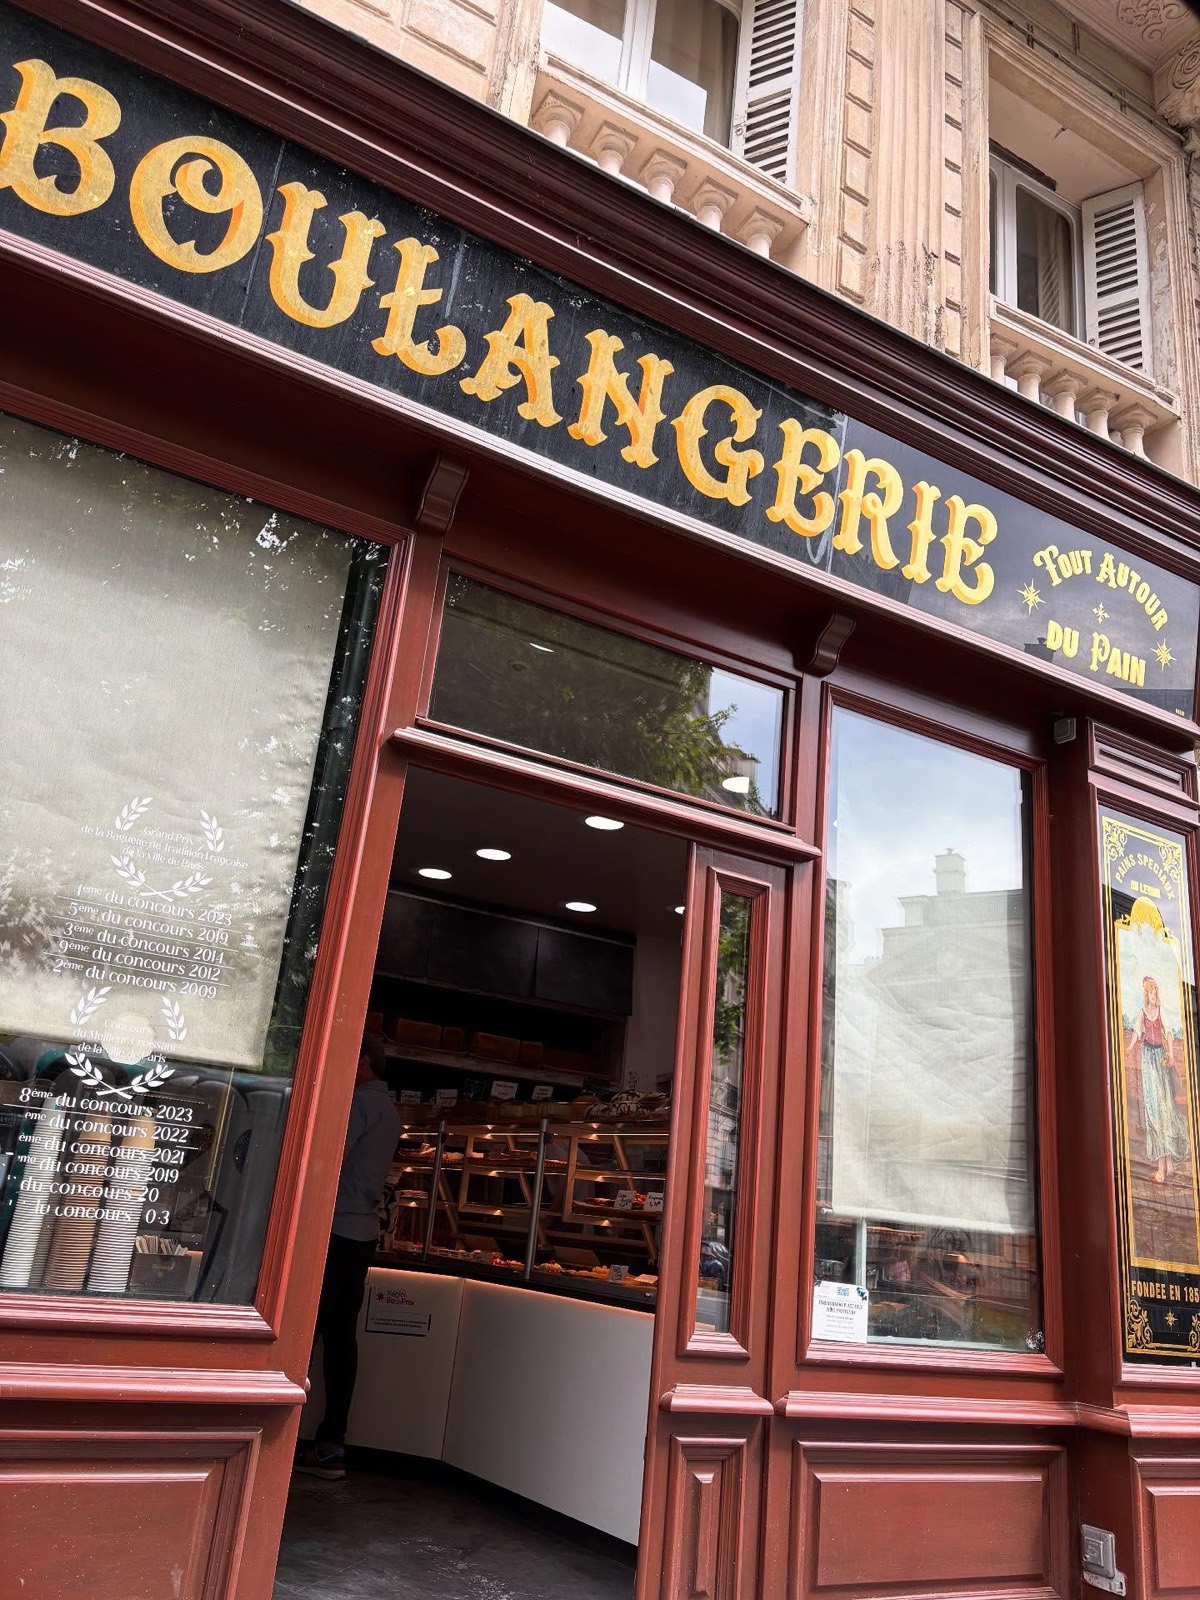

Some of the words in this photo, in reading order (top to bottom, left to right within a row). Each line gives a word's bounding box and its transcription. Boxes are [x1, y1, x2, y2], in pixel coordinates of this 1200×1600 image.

[0, 58, 998, 605] BOULANGERIE
[1046, 620, 1080, 658] DU
[1115, 854, 1136, 883] PAINS
[105, 888, 124, 904] du
[127, 895, 195, 919] concours
[101, 908, 121, 925] du
[124, 916, 194, 938] concours
[196, 927, 229, 946] 2019
[97, 928, 117, 945] du
[119, 934, 190, 958] concours
[193, 945, 225, 965] 2014
[92, 946, 112, 963] du
[115, 953, 186, 976] concours
[188, 962, 221, 981] 2012
[85, 963, 105, 981] du
[108, 971, 177, 993] concours
[179, 980, 217, 999] 2009
[77, 1041, 91, 1053] de
[92, 1042, 103, 1054] la
[55, 1092, 77, 1109] du
[80, 1097, 153, 1118] concours
[156, 1104, 193, 1123] 2023
[49, 1114, 71, 1131] du
[74, 1119, 148, 1139] concours
[150, 1126, 189, 1144] 2022
[44, 1134, 67, 1152] du
[70, 1140, 147, 1160] concours
[149, 1147, 185, 1165] 2021
[39, 1154, 62, 1173] du
[65, 1160, 141, 1180] concours
[145, 1166, 179, 1184] 2019
[20, 1174, 43, 1192] du
[49, 1180, 133, 1201] concours
[1169, 1284, 1181, 1302] EN
